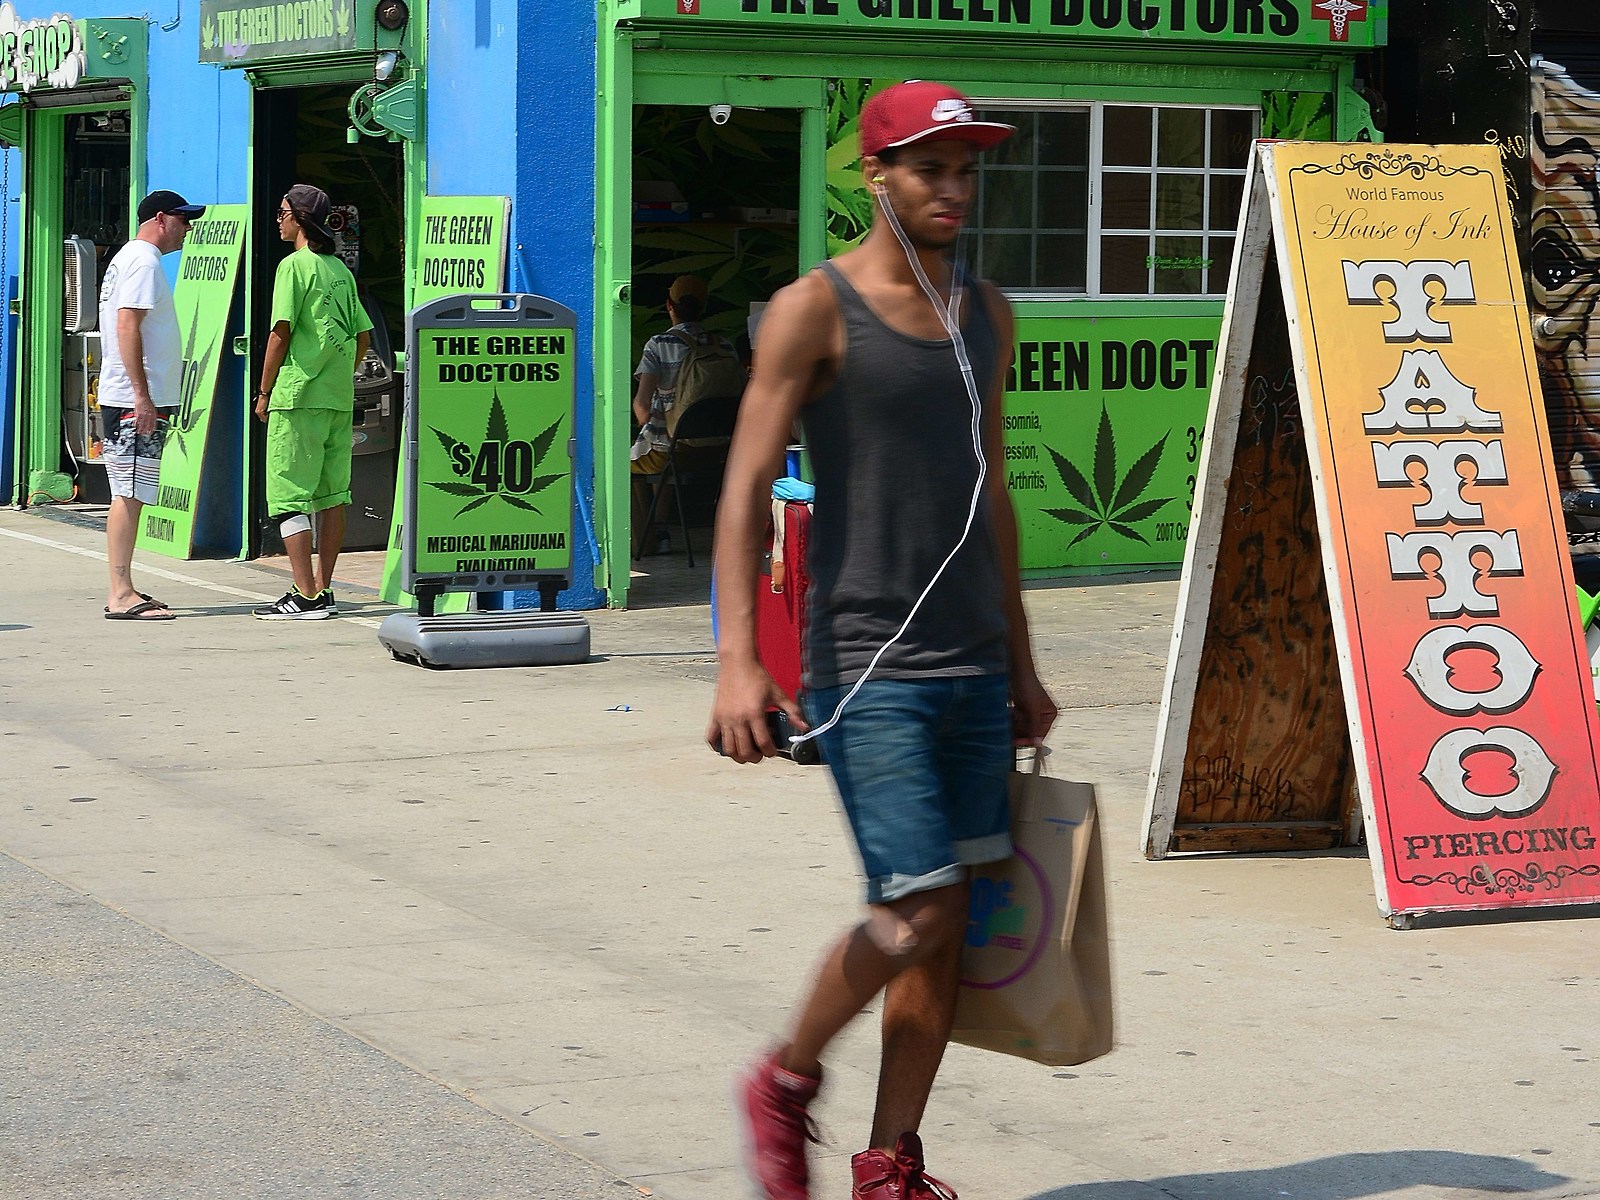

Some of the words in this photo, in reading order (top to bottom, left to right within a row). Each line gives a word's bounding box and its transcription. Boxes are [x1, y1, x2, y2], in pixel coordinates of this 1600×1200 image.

[217, 10, 238, 48] THE
[239, 5, 276, 46] GREEN
[21, 19, 72, 78] SHOP
[1346, 187, 1388, 201] World
[1392, 187, 1444, 201] Famous
[189, 220, 208, 245] THE
[206, 220, 240, 245] GREEN
[425, 216, 447, 245] THE
[449, 216, 493, 245] GREEN
[1313, 204, 1399, 240] House
[1404, 212, 1432, 250] of
[1432, 207, 1492, 240] Ink
[183, 255, 228, 281] DOCTORS
[423, 258, 485, 289] DOCTORS
[432, 336, 480, 357] THE
[486, 335, 566, 357] GREEN
[438, 362, 561, 383] DOCTORS
[1006, 341, 1090, 392] REEN
[1101, 339, 1218, 391] DOCT
[1001, 410, 1042, 433] nsomnia,
[1002, 441, 1039, 462] ression,
[451, 440, 534, 495] $40
[1007, 470, 1048, 492] Arthritis,
[427, 535, 487, 553] MEDICAL
[489, 532, 566, 552] MARIJUANA
[1155, 522, 1175, 541] 2007
[1342, 260, 1560, 821] TATTOO
[1404, 826, 1597, 860] PIERCING
